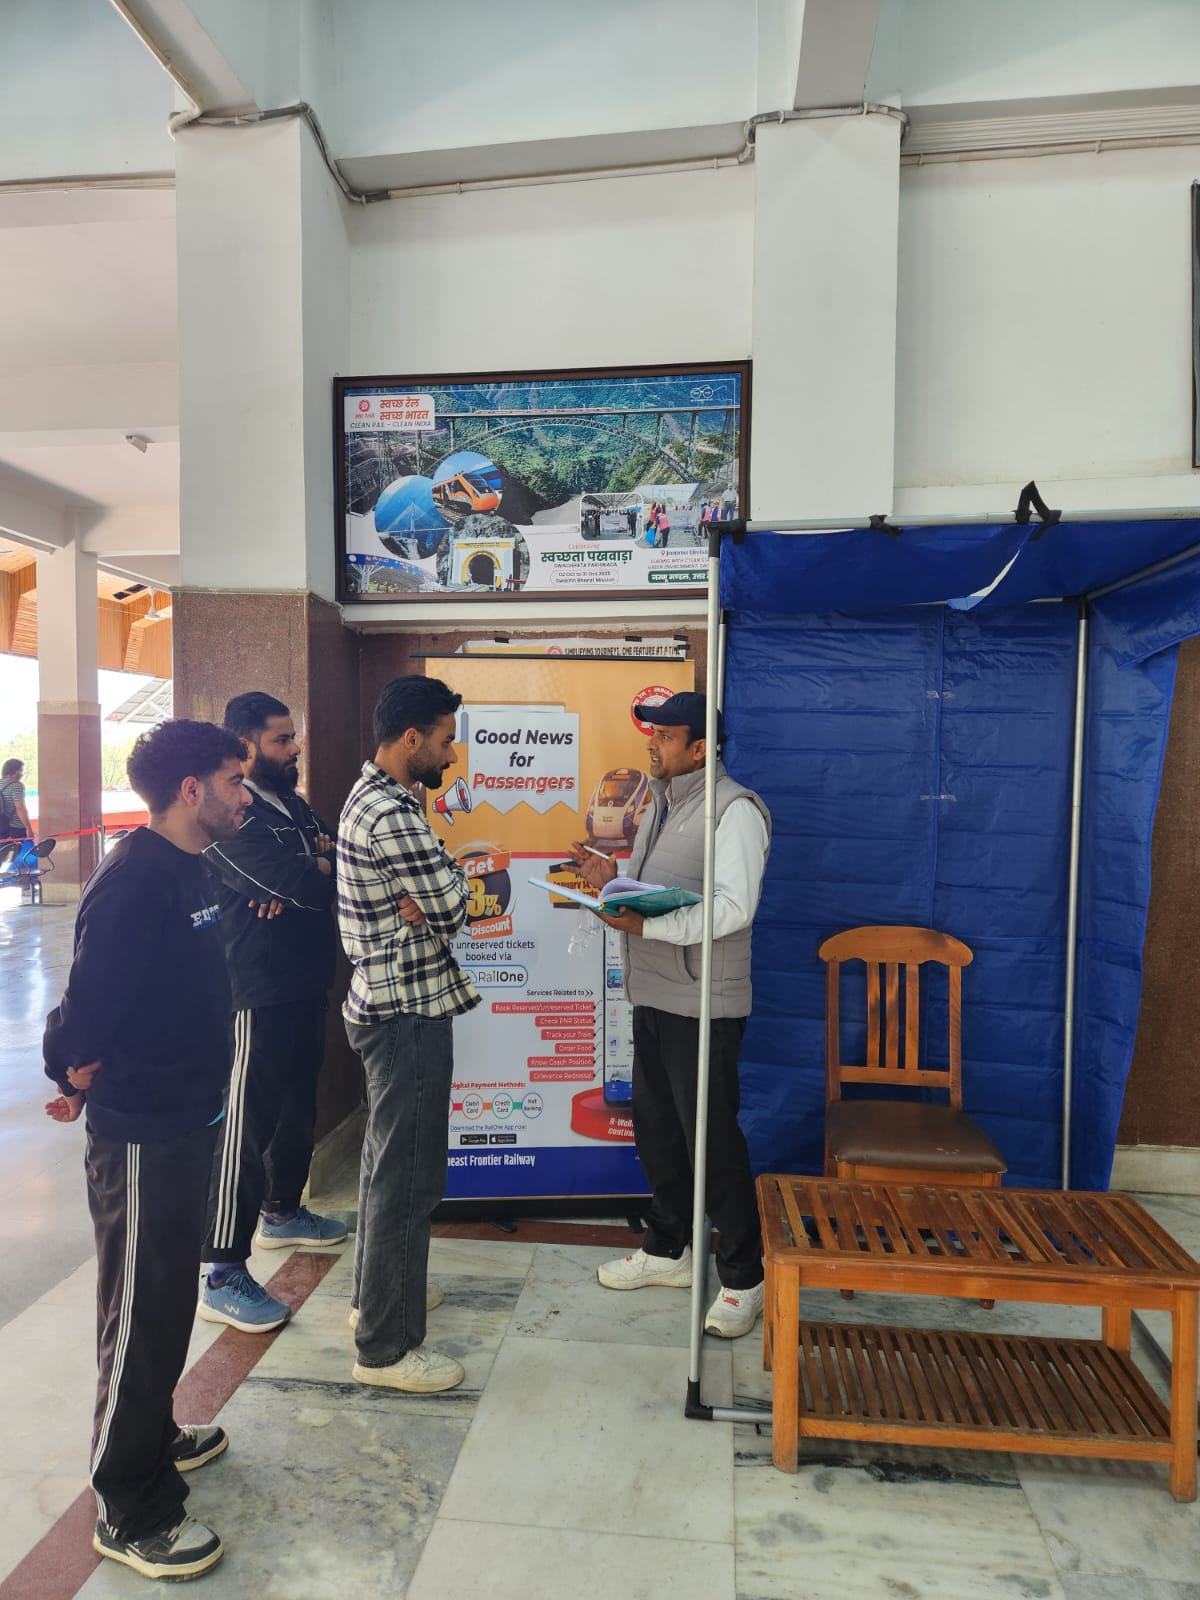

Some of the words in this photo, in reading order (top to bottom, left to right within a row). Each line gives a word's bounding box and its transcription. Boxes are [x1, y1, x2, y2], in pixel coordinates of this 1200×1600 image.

[380, 398, 403, 408] स्वच्छ
[405, 396, 420, 408] रेल
[380, 411, 403, 421] स्वच्छ
[405, 410, 429, 420] भारत
[540, 551, 585, 562] स्वच्छता
[586, 550, 633, 564] पखवाड़ा
[633, 646, 655, 656] FEATURE
[475, 729, 522, 745] Good
[525, 729, 574, 745] News
[509, 752, 535, 768] for
[473, 773, 575, 795] Passengers
[463, 857, 494, 876] Get
[465, 878, 502, 917] 3%
[471, 918, 511, 936] Discount
[456, 940, 504, 949] unreserved
[506, 940, 535, 949] tickets
[465, 952, 497, 961] booked
[498, 952, 512, 961] via
[478, 970, 524, 983] RailOne
[495, 1004, 511, 1012] Book
[540, 1017, 558, 1025] Check
[469, 1153, 502, 1166] Frontier
[503, 1154, 536, 1167] Railway
